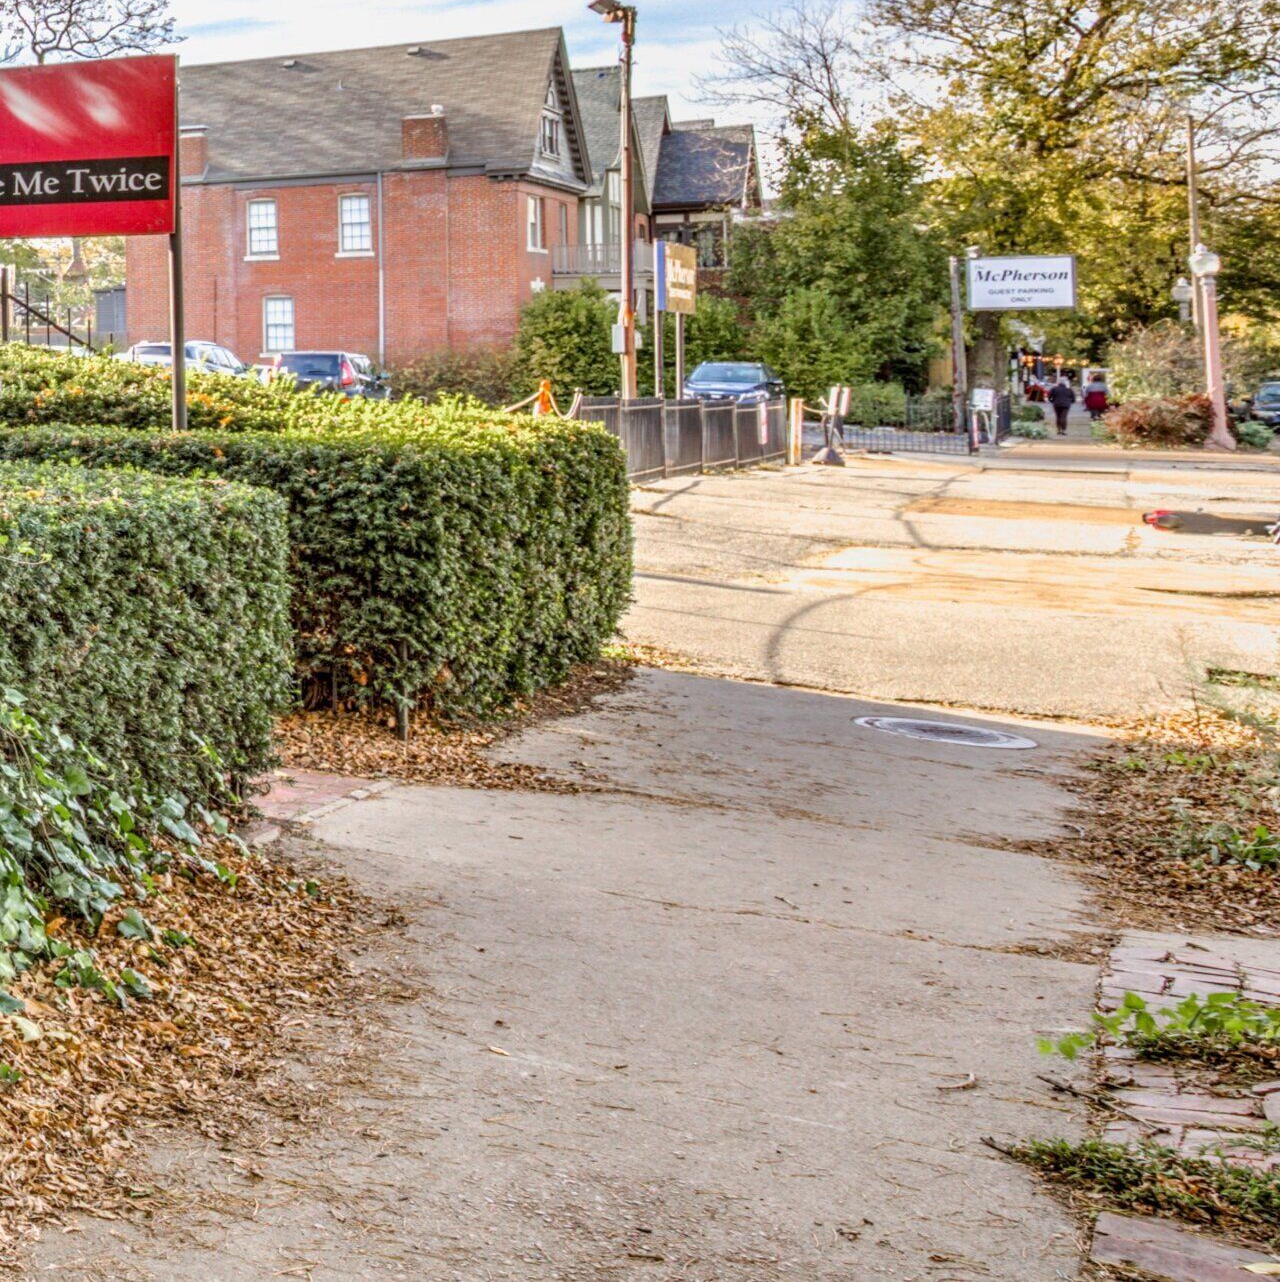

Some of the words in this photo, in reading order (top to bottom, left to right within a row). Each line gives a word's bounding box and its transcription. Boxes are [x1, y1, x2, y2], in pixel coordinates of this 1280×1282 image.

[12, 169, 60, 196] Me
[66, 167, 163, 194] Twice
[975, 269, 1069, 282] McPherson
